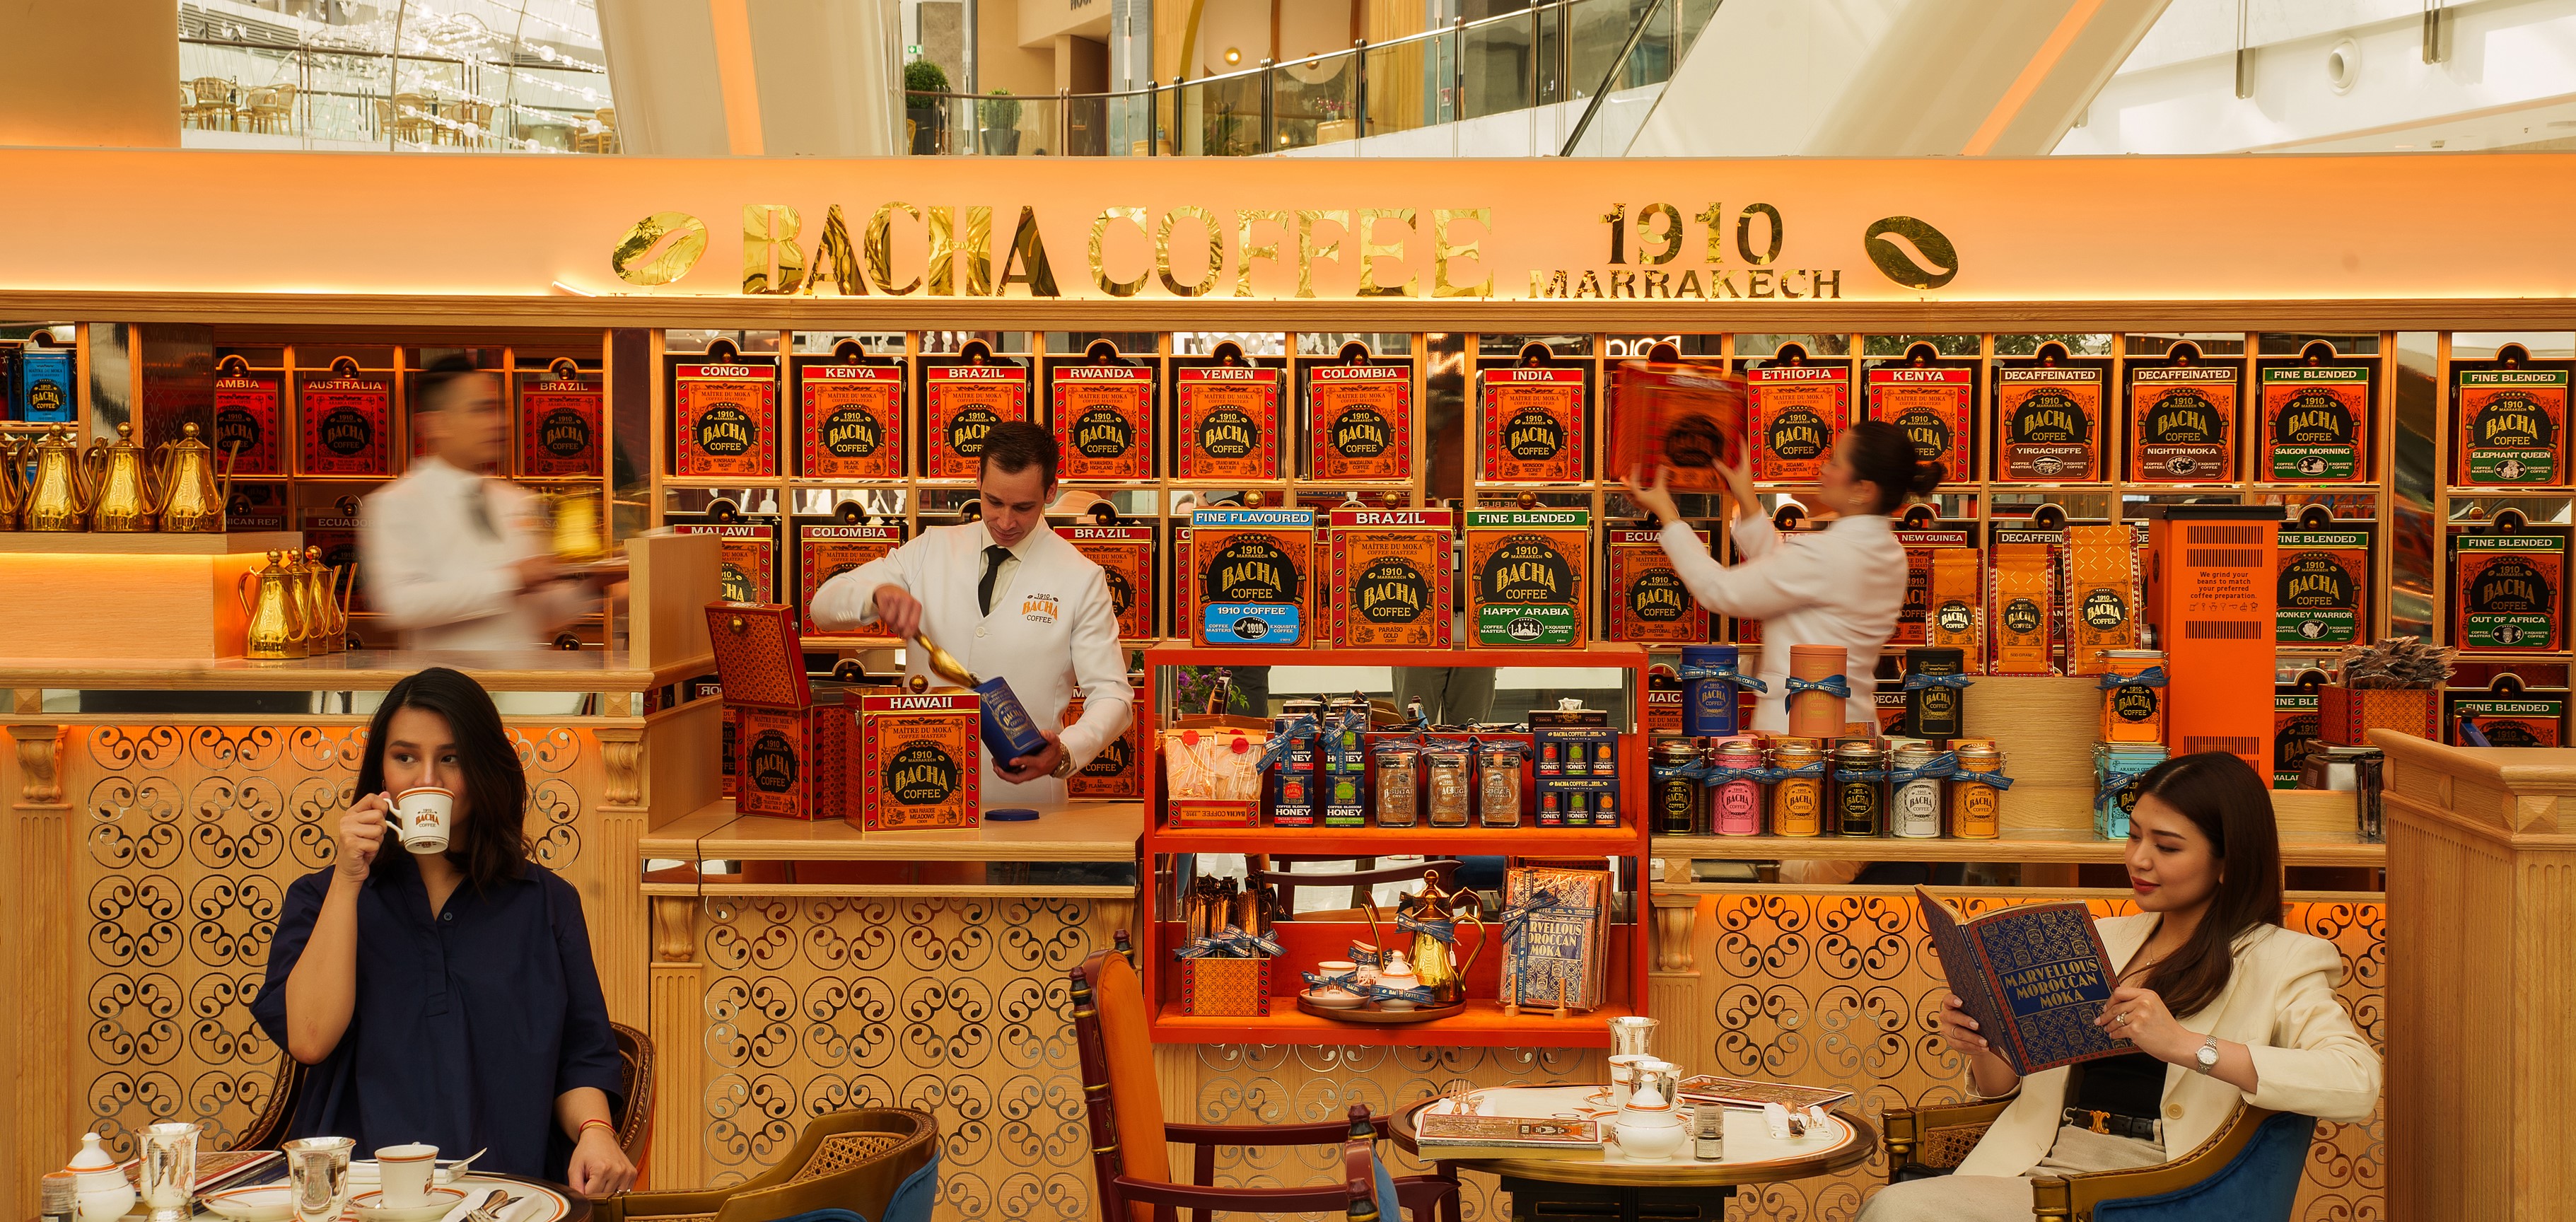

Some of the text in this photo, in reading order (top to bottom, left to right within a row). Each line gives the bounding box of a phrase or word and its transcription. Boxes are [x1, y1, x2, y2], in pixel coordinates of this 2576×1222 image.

[1600, 202, 1781, 264] 1910
[742, 202, 1494, 298] BACHA COFFEE
[1528, 268, 1841, 299] MARRAKECH
[701, 367, 750, 376] CONGO
[826, 368, 875, 378] KENYA
[949, 368, 1004, 378] BRAZIL
[1071, 369, 1134, 378] RWANDA
[1201, 370, 1254, 379] YEMEN
[1322, 368, 1397, 379] COLOMBIA
[1513, 371, 1554, 380] INDIA
[1761, 369, 1831, 380] ETHIOPIA
[1893, 371, 1945, 380] KENYA
[2005, 371, 2096, 380] DECAFFEINATED
[2138, 370, 2231, 380] DECAFFEINATED
[216, 380, 260, 388] AMBIA
[309, 381, 383, 390] AUSTRALIA
[540, 383, 588, 391] BRAZIL
[33, 392, 59, 405] BACHA
[2024, 410, 2074, 436] BACHA
[2157, 410, 2208, 436] BACHA
[2288, 410, 2339, 436] BACHA
[2486, 414, 2538, 440] BACHA
[327, 424, 365, 444] BACHA
[547, 426, 583, 446] BACHA
[704, 422, 748, 446] BACHA
[829, 424, 875, 448] BACHA
[1080, 424, 1125, 448] BACHA
[1206, 424, 1250, 448] BACHA
[1339, 424, 1384, 448] BACHA
[1511, 426, 1556, 450] BACHA
[1776, 426, 1821, 450] BACHA
[2032, 432, 2067, 441] COFFEE
[2165, 432, 2201, 441] COFFEE
[2296, 433, 2332, 441] COFFEE
[2494, 436, 2530, 445] COFFEE
[1213, 445, 1243, 453] COFFEE
[1346, 444, 1377, 453] COFFEE
[1518, 447, 1549, 455] COFFEE
[1783, 446, 1814, 455] COFFEE
[1196, 513, 1310, 523] FINE FLAVOURED
[1356, 513, 1426, 524] BRAZIL
[1478, 513, 1575, 523] FINE BLENDED
[691, 527, 754, 536] MALAWI
[812, 528, 887, 537] COLOMBIA
[1075, 529, 1130, 538] BRAZIL
[1240, 545, 1264, 554] 1910
[1222, 561, 1282, 593] BACHA
[1496, 561, 1556, 593] BACHA
[2289, 574, 2341, 600] BACHA
[2483, 578, 2535, 605] BACHA
[1231, 588, 1273, 599] COFFEE
[1363, 582, 1419, 611] BACHA
[1505, 589, 1548, 600] COFFEE
[1637, 588, 1682, 612] BACHA
[2297, 597, 2332, 605] COFFEE
[2491, 601, 2527, 610] COFFEE
[1022, 600, 1059, 621] BACHA
[1372, 607, 1411, 617] COFFEE
[1644, 608, 1675, 617] COFFEE
[2087, 604, 2121, 621] BACHA
[1027, 615, 1052, 624] COFFEE
[1702, 689, 1726, 702] BACHA
[1926, 692, 1950, 704] BACHA
[890, 697, 952, 709] HAWAII
[2119, 695, 2152, 712] BACHA
[895, 764, 949, 793] BACHA
[904, 789, 940, 799] COFFEE
[1727, 793, 1749, 806] BACHA
[1790, 794, 1813, 806] BACHA
[416, 813, 439, 825] BACHA
[1530, 945, 1561, 957] MOKA
[2004, 958, 2099, 989] MARVELLOUS
[2016, 973, 2098, 1001] MOROCCAN
[2040, 989, 2085, 1009] MOKA
